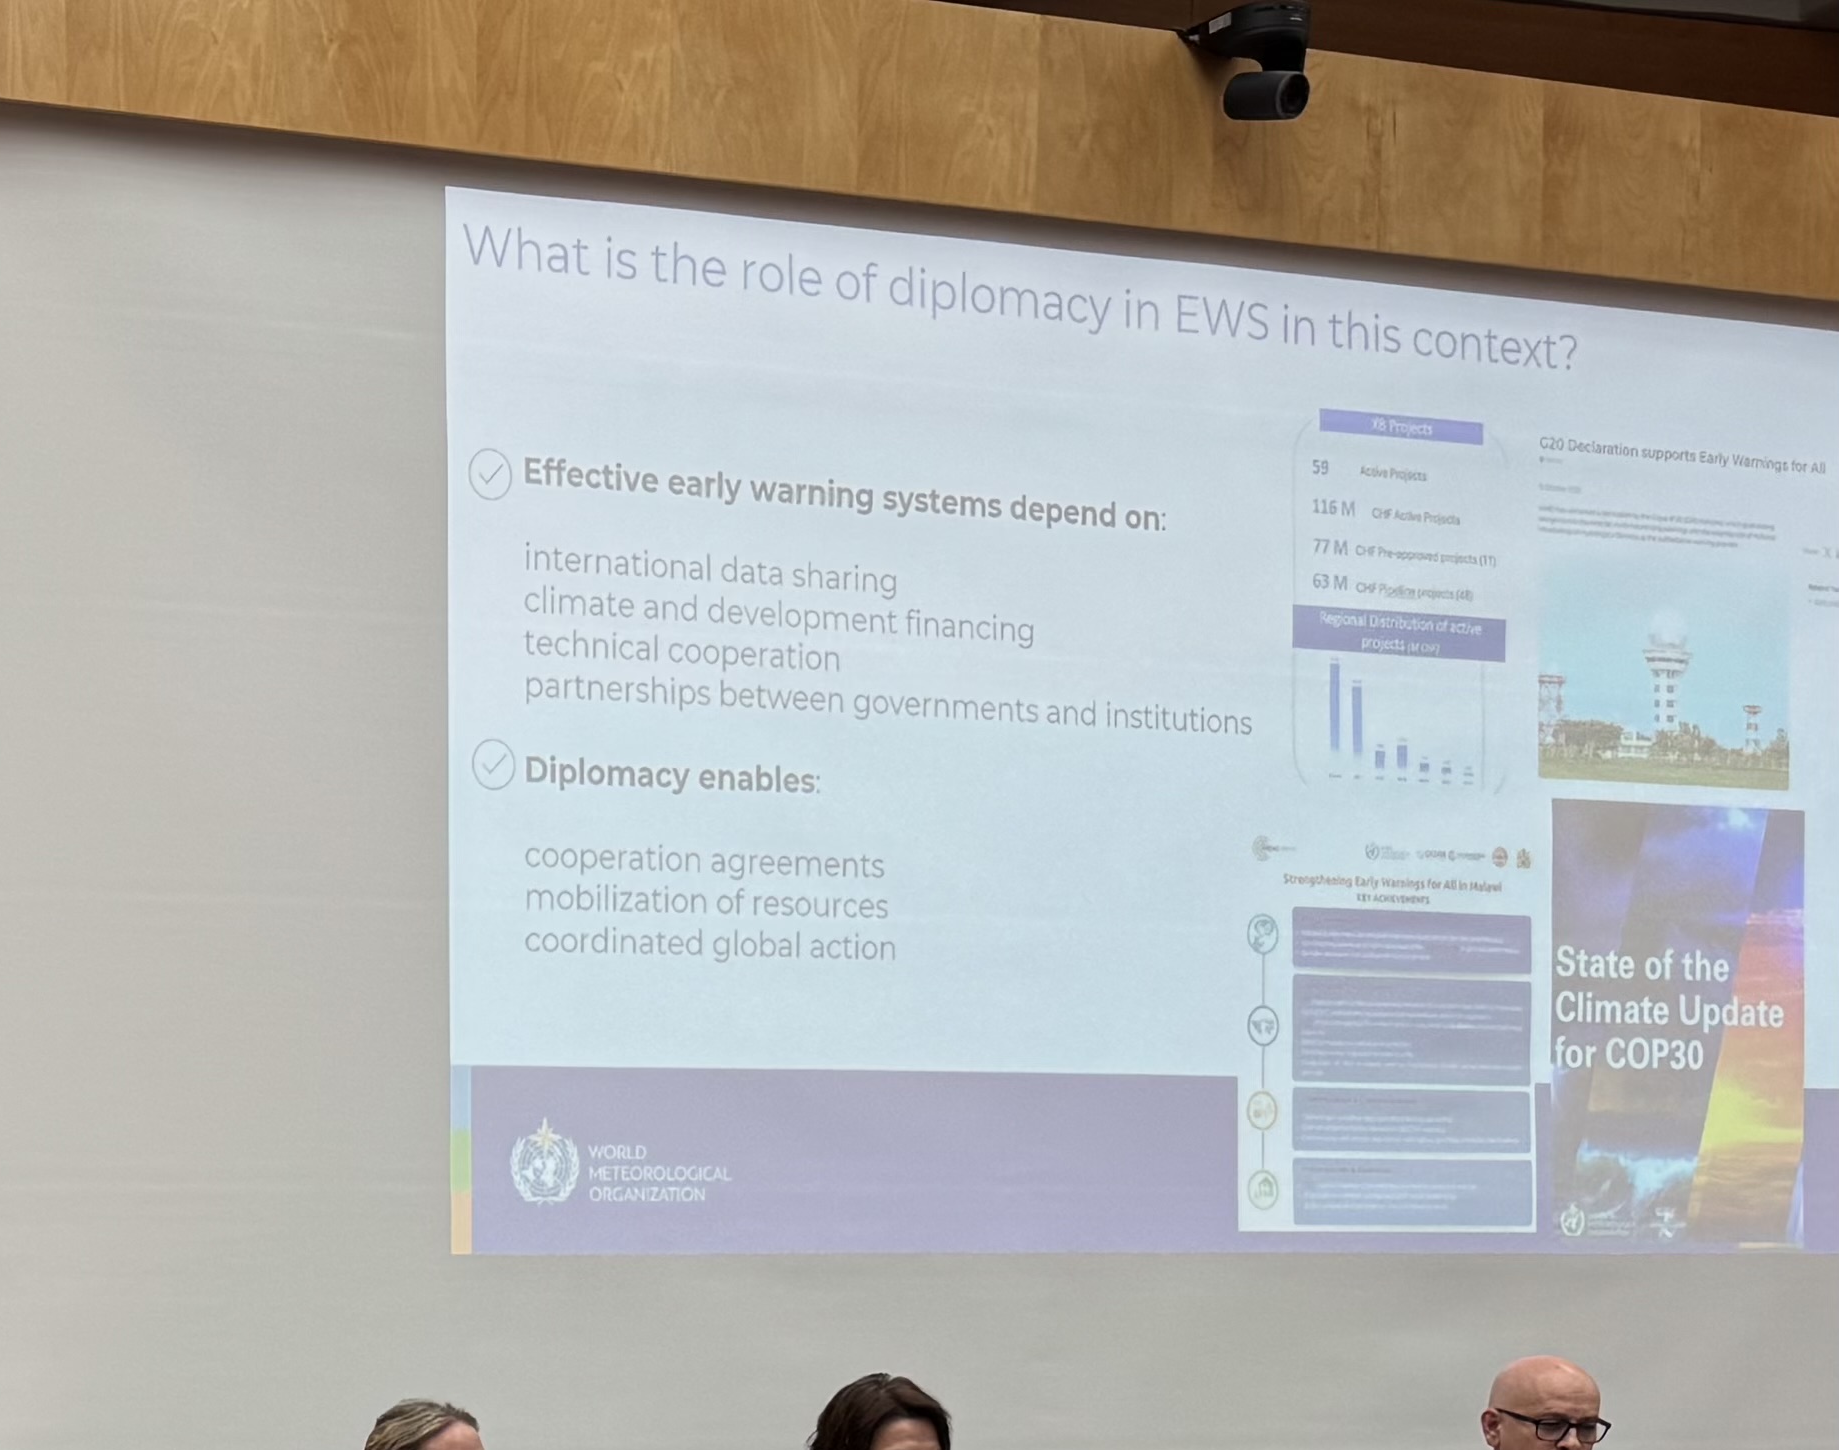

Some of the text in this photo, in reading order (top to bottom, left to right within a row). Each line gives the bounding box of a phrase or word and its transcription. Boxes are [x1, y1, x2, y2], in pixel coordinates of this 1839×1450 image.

[462, 223, 1579, 371] What is the role of diplomacy in EWS in this context?
[1389, 419, 1434, 437] Projects
[1312, 459, 1329, 476] 59
[1539, 436, 1827, 475] G20 Declaration supports Early Warnings for All
[524, 456, 1167, 532] Effective early warning systems depend on:
[1313, 498, 1338, 515] 116
[1341, 501, 1356, 517] M
[1313, 538, 1331, 554] 77
[1334, 540, 1349, 556] M
[524, 541, 897, 600] international data sharing
[1312, 573, 1330, 589] 63
[1333, 575, 1349, 591] M
[523, 584, 1035, 649] climate and development financing
[1320, 611, 1367, 629] Regional
[1369, 614, 1434, 632] Distribution
[523, 629, 841, 674] technical cooperation
[525, 674, 1253, 735] partnerships between governments and institutions
[524, 755, 822, 796] Diplomacy enables:
[524, 844, 886, 881] cooperation agreements
[525, 883, 889, 920] mobilization of resources
[524, 926, 897, 964] coordinated global action
[1555, 944, 1635, 980] State
[1644, 948, 1675, 981] of
[1681, 949, 1730, 983] the
[1555, 990, 1785, 1034] Climate Update
[1554, 1035, 1598, 1069] for
[1605, 1036, 1704, 1071] COP30
[588, 1144, 647, 1160] WORLD
[589, 1165, 733, 1182] METEOROLOGICAL
[589, 1186, 706, 1202] ORGANIZATION
